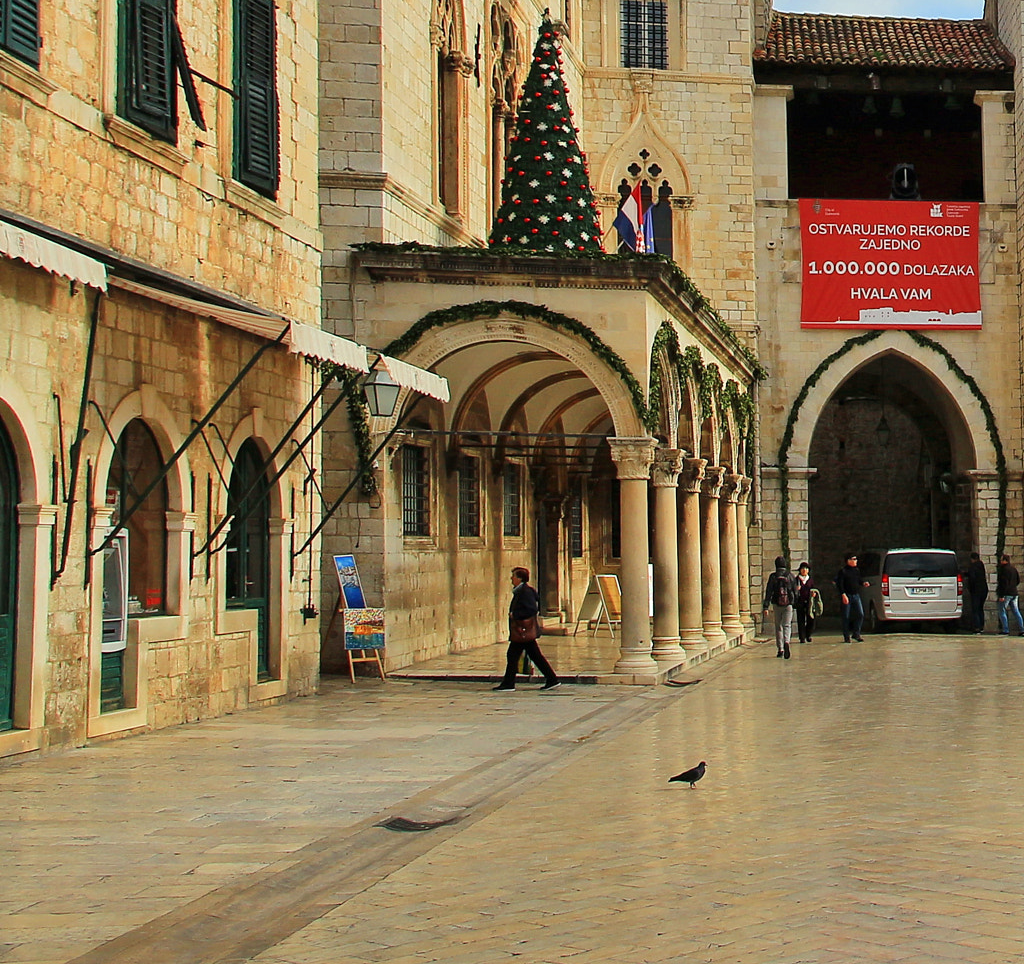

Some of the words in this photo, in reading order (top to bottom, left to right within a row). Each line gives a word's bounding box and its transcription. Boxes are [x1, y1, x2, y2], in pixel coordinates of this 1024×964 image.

[808, 223, 907, 236] OSTVARUJEMO
[909, 225, 971, 237] REKORDE
[859, 238, 921, 250] ZAJEDNO
[808, 261, 900, 275] 1.000.000
[903, 264, 975, 276] DOLAZAKA
[850, 287, 898, 300] HVALA
[900, 288, 932, 300] VAM
